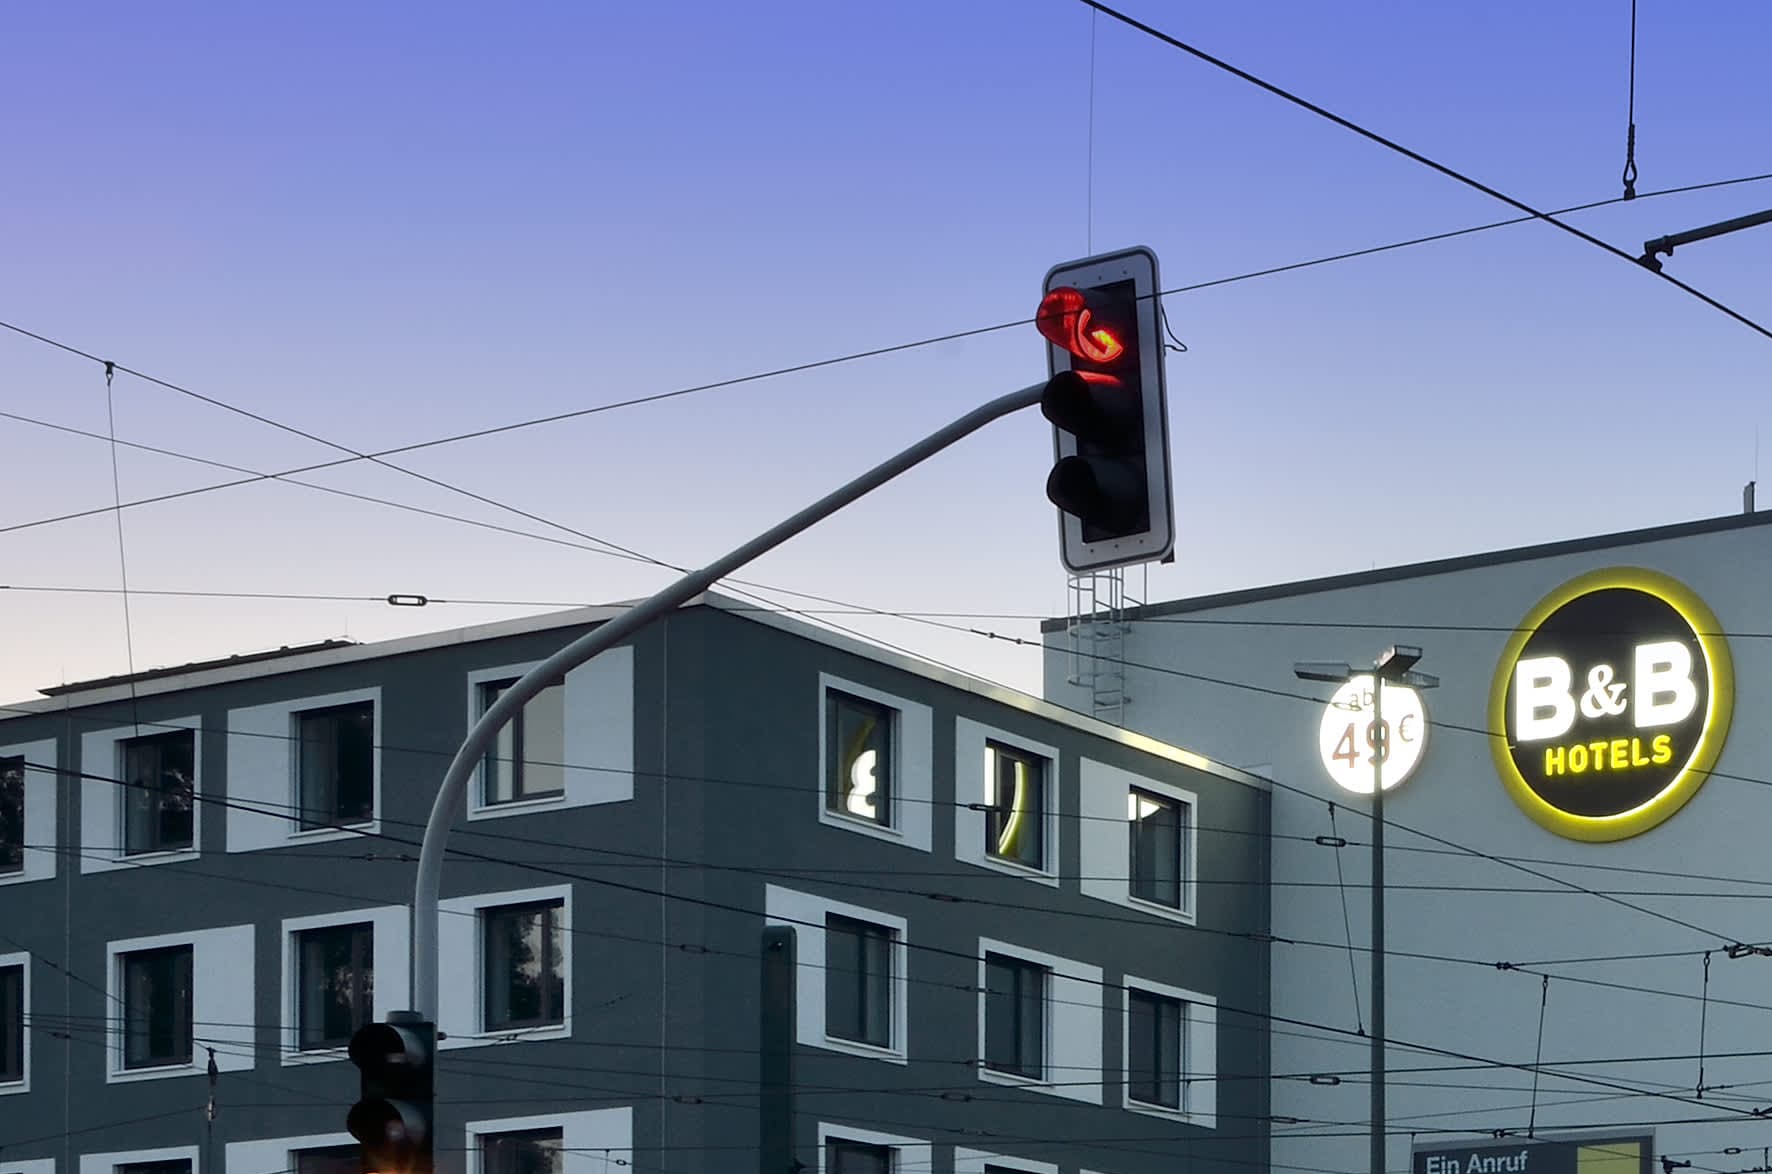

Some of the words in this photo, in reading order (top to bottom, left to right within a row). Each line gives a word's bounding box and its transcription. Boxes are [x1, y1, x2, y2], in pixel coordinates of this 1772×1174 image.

[1516, 641, 1697, 741] B&B
[1545, 735, 1672, 776] HOTELS
[1466, 1150, 1528, 1174] Anruf
